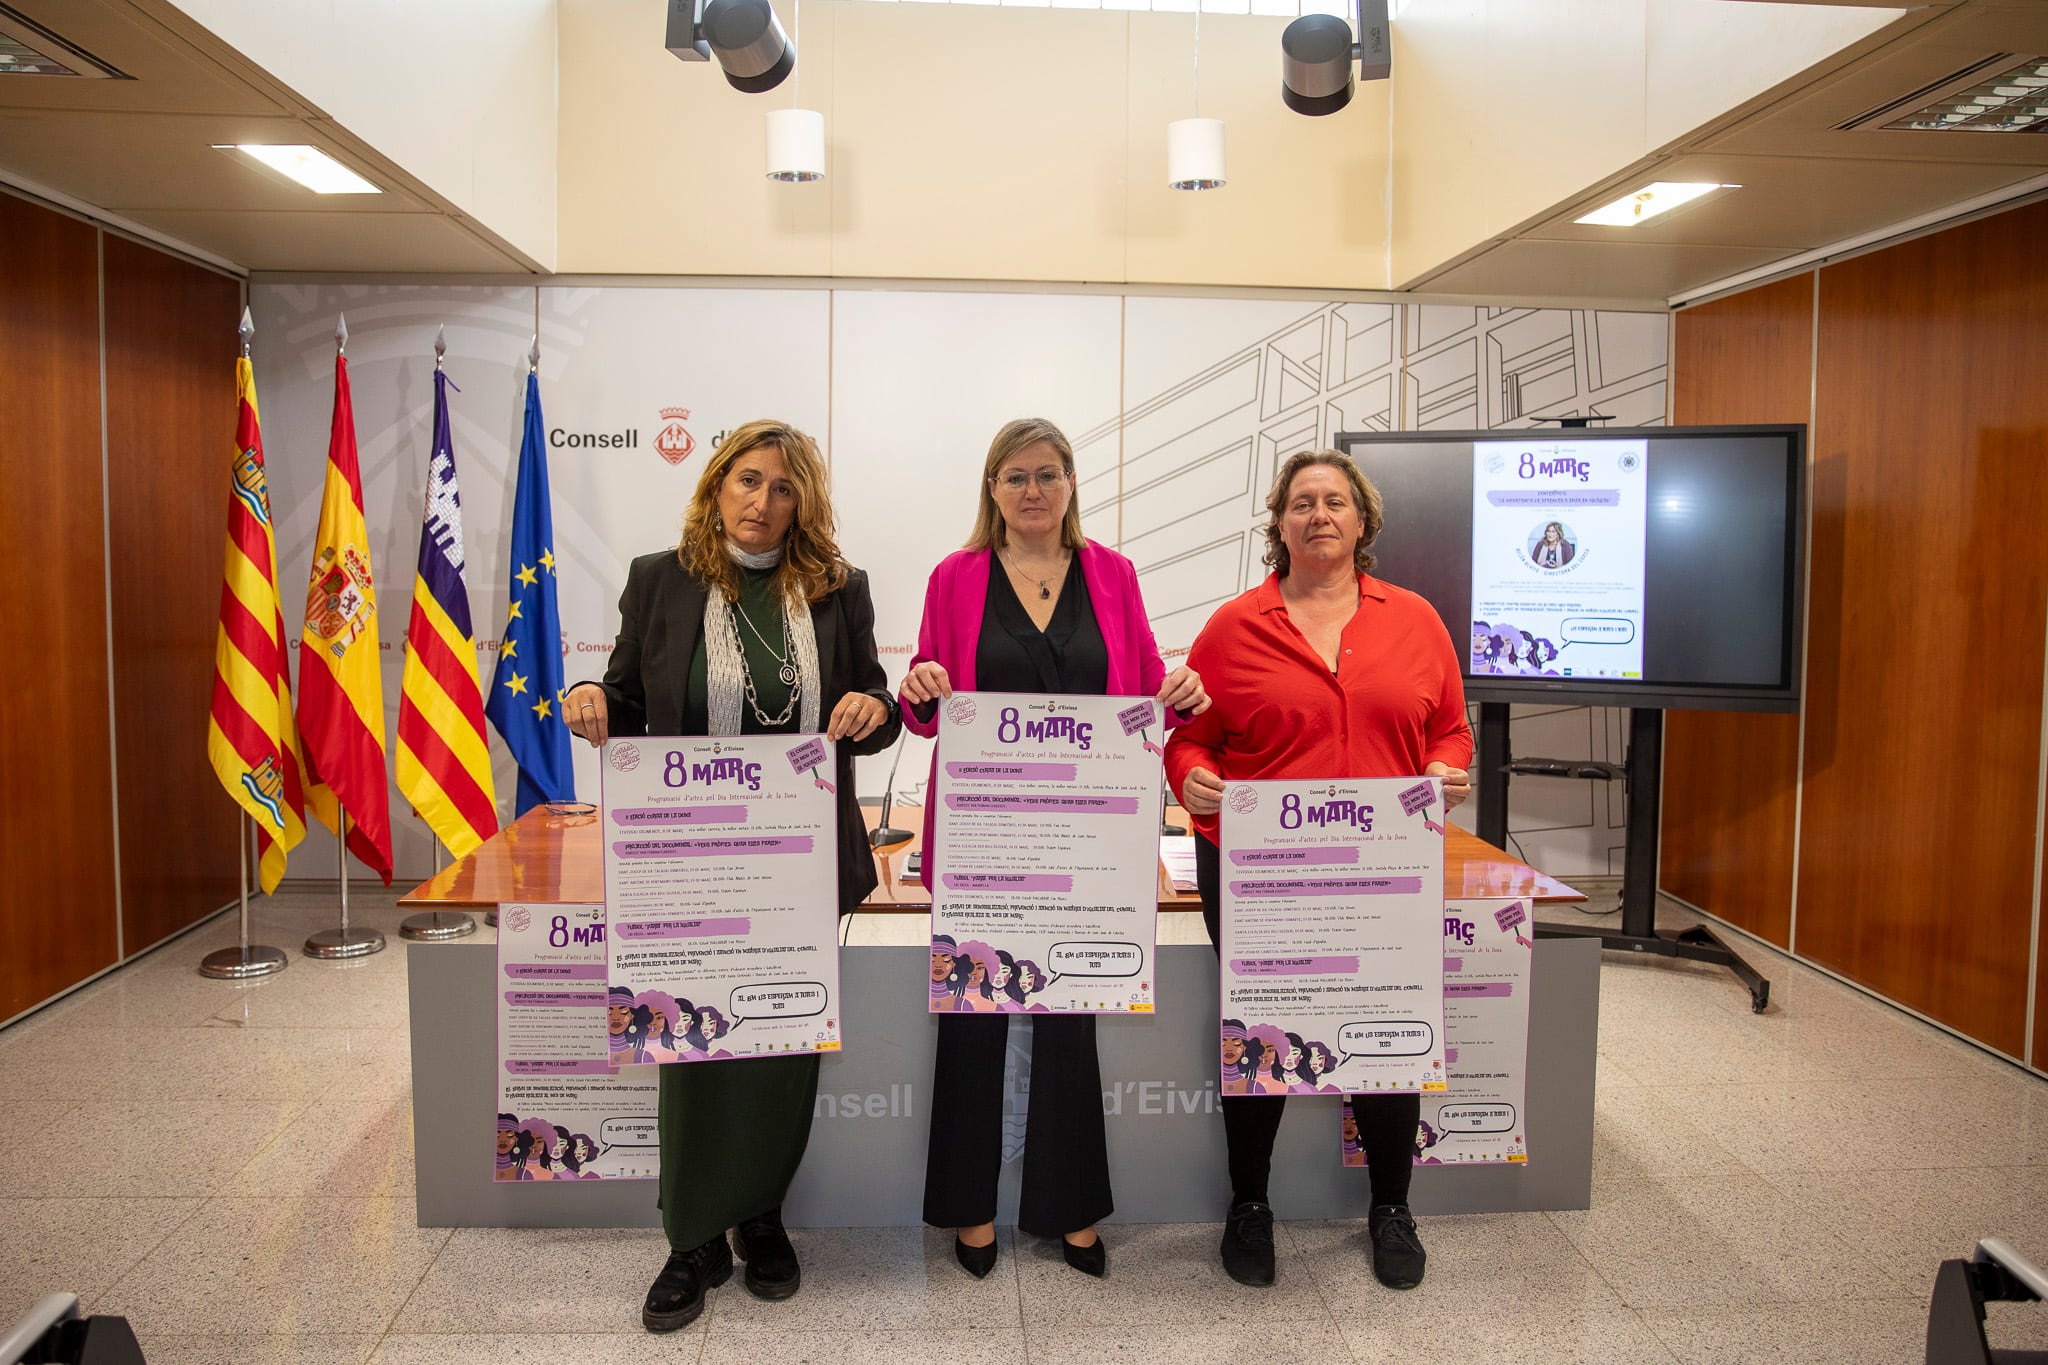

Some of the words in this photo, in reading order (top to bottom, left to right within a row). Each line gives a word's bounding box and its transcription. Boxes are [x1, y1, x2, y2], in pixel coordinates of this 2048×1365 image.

[550, 429, 638, 448] Consell
[1519, 452, 1535, 478] 8
[1539, 458, 1590, 482] MARÇ
[577, 642, 614, 652] Conse
[877, 644, 913, 654] onsell
[1158, 646, 1190, 656] Cons
[998, 707, 1020, 743] 8
[1026, 717, 1093, 750] MARÇ
[663, 751, 686, 787] 8
[692, 758, 762, 792] MARÇ
[1280, 794, 1302, 829] 8
[1307, 800, 1374, 834] MARÇ
[549, 916, 569, 947] 8
[574, 924, 605, 947] MA
[1444, 918, 1475, 945] RÇ
[816, 1084, 912, 1118] nsell
[1102, 1080, 1224, 1115] d'Eivi
